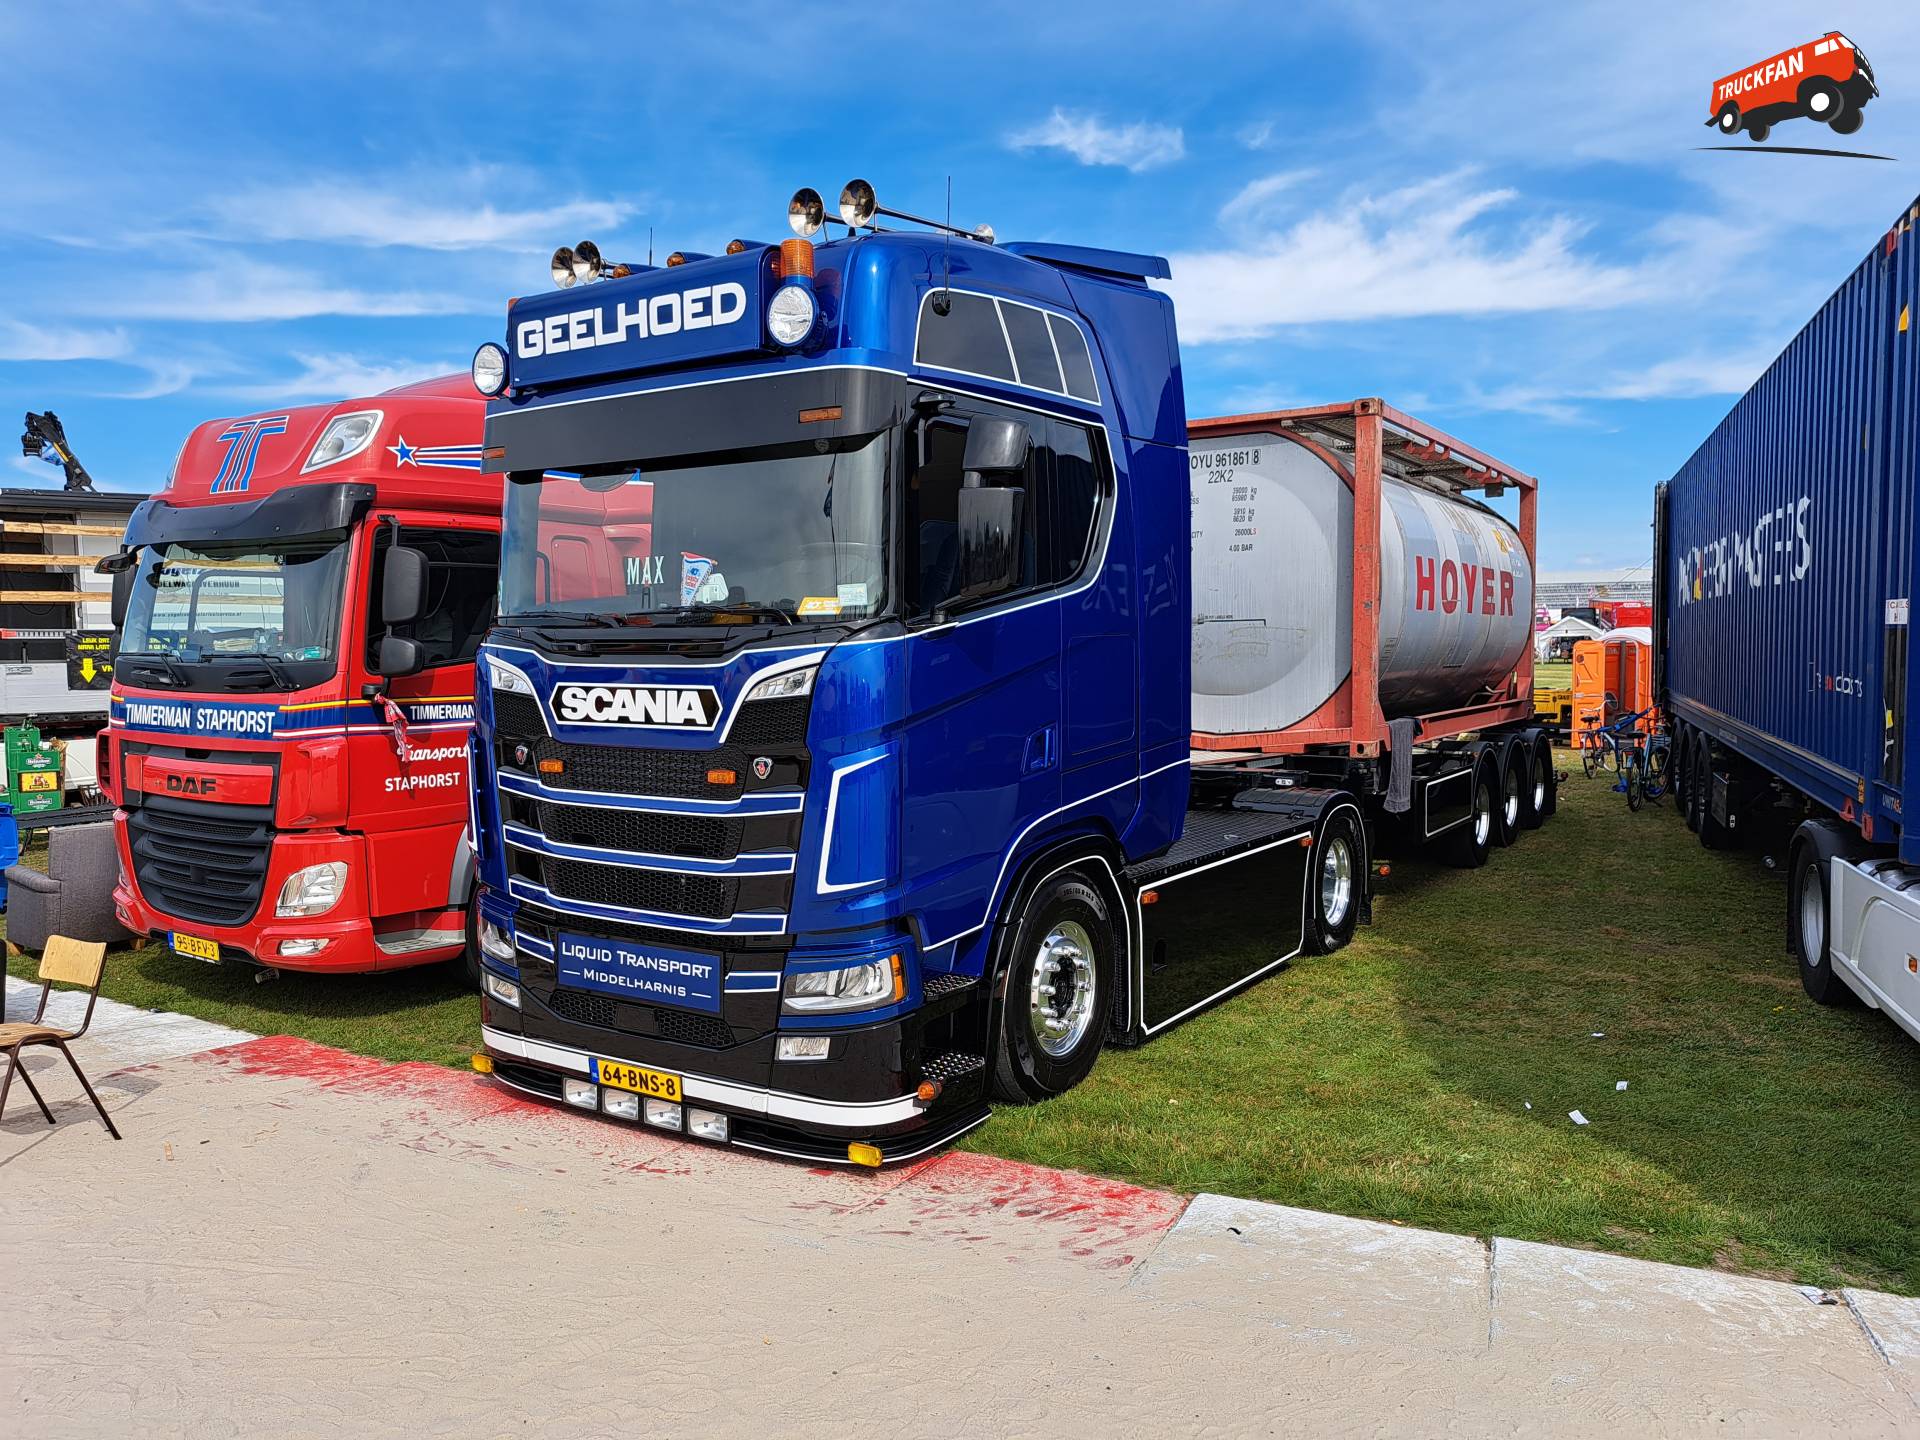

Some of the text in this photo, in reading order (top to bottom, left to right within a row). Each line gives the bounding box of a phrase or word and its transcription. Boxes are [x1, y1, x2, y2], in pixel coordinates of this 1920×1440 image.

[517, 282, 747, 359] GEELHOED
[1190, 454, 1213, 469] OYU
[1215, 450, 1250, 467] 961861
[1208, 469, 1234, 484] 22K2
[1241, 543, 1253, 552] BAR
[627, 555, 665, 585] MAX
[1415, 555, 1514, 617] HOYER
[125, 703, 275, 734] TIMMERMAN STAPHORST
[410, 704, 475, 720] TIMMERMAN
[560, 687, 708, 726] SCANIA
[167, 774, 217, 795] DAF
[385, 772, 460, 792] STAPHORST
[176, 935, 215, 958] 95-BFV-3
[562, 941, 712, 979] LIQUID TRANSPORT
[583, 968, 686, 997] MIDDELHARNIS
[602, 1064, 676, 1096] 64-BNS-8
